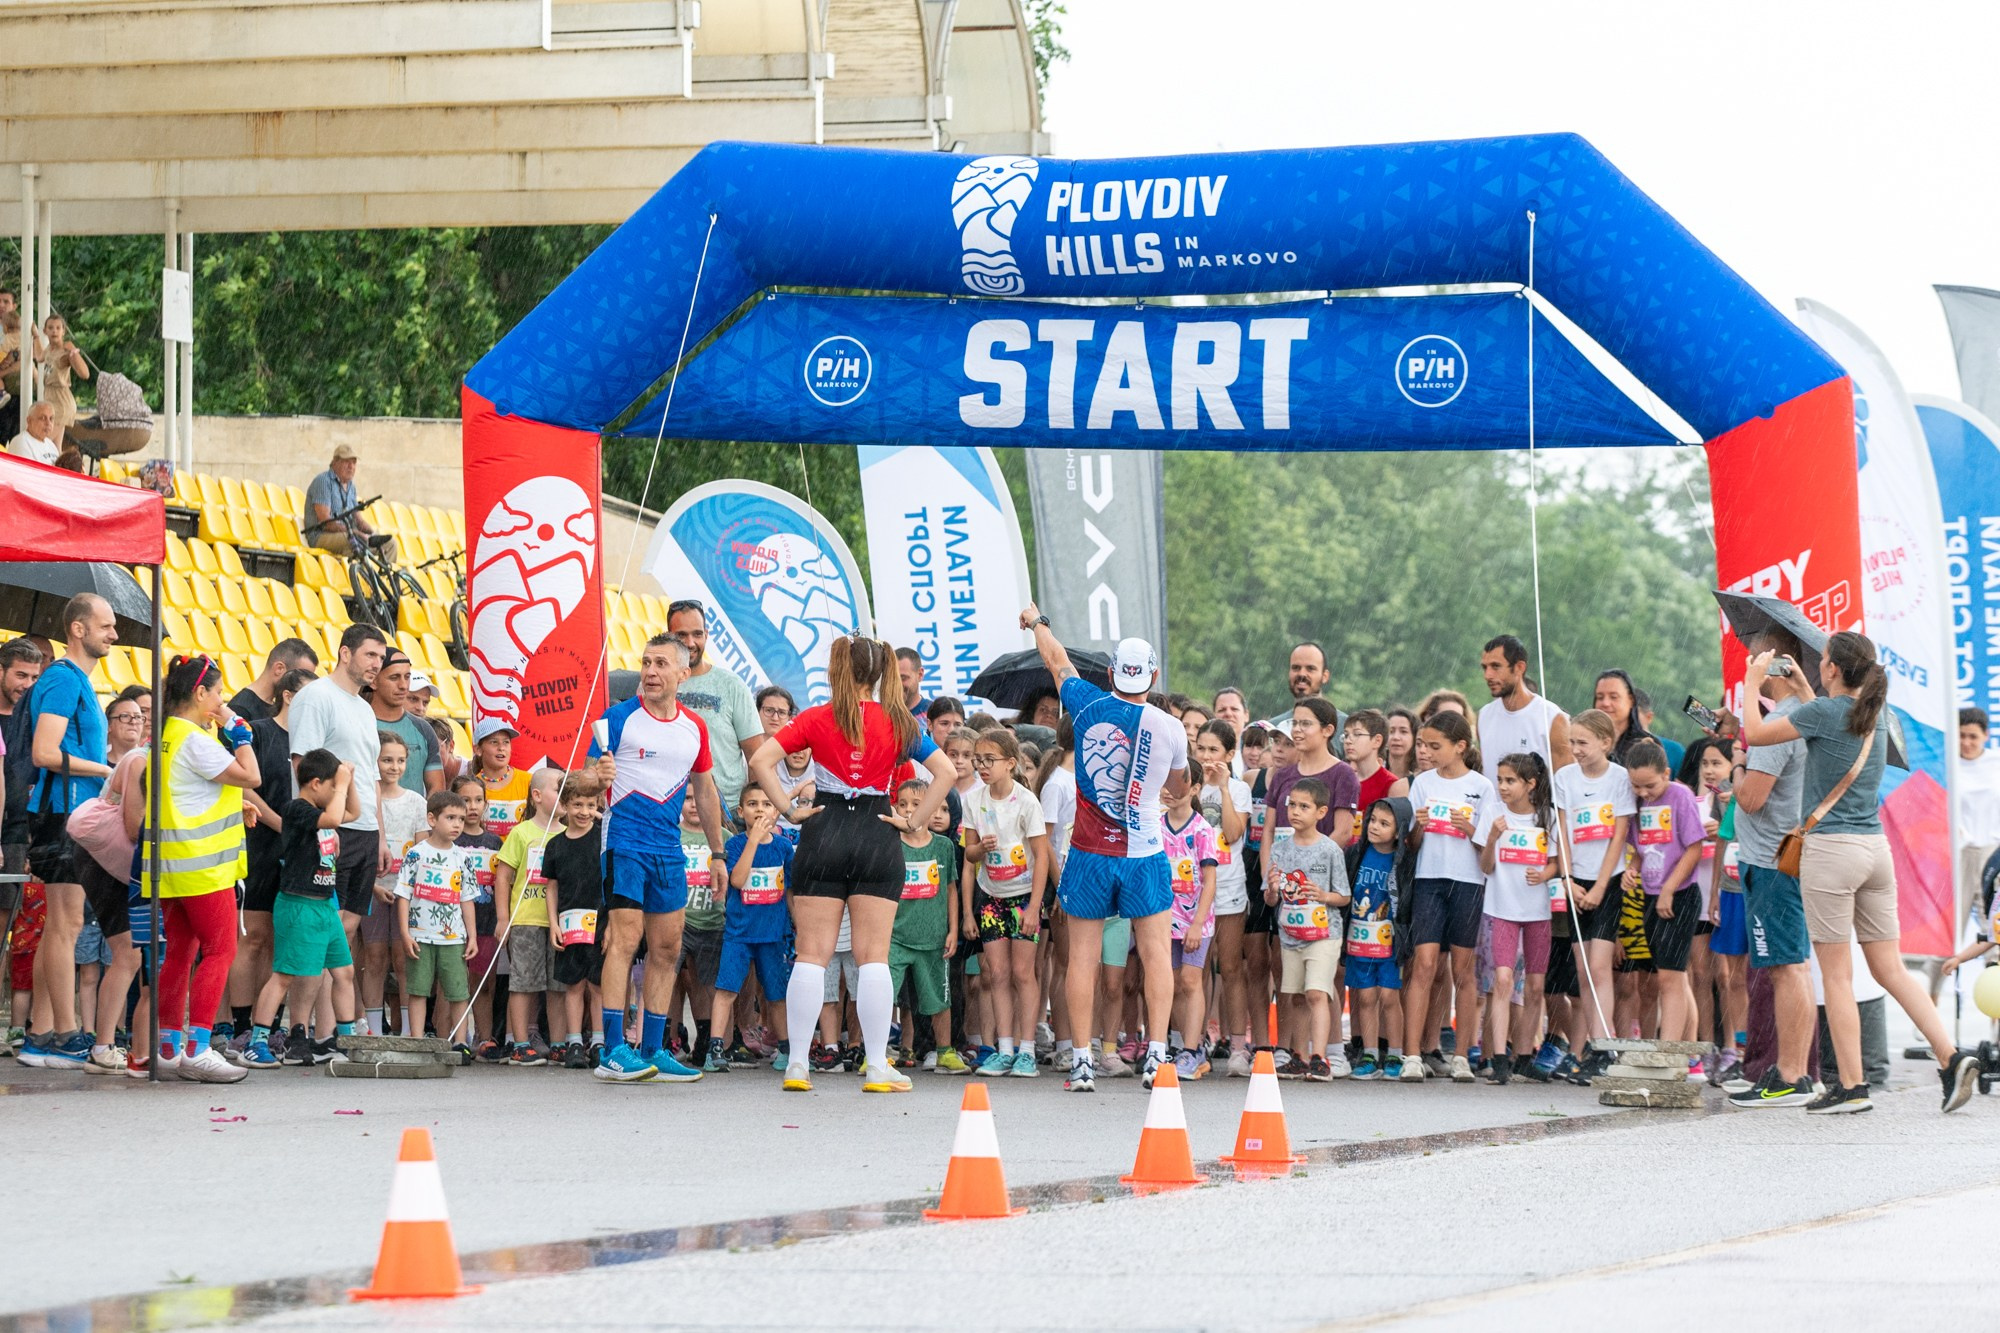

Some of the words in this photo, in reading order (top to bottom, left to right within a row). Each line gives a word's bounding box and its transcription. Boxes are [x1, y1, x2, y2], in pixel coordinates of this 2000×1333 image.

[1046, 174, 1228, 223] PLOVDIV
[1175, 236, 1199, 250] IN
[1045, 232, 1165, 276] HILLS
[1178, 251, 1298, 268] MARKOVO
[816, 357, 860, 380] P/H
[958, 317, 1310, 430] START
[1408, 357, 1455, 381] P/H
[521, 675, 578, 701] PLOVDIV
[535, 695, 574, 716] HILLS
[520, 724, 547, 743] TRAIL
[553, 733, 573, 742] RUN
[1134, 728, 1152, 782] MATTERS
[489, 807, 508, 820] 26
[1432, 804, 1449, 817] 47
[1576, 811, 1591, 825] 48
[1509, 833, 1528, 847] 46
[423, 870, 443, 885] 36
[751, 875, 769, 887] 81
[524, 887, 539, 899] SIX
[565, 917, 570, 929] 1
[1287, 912, 1305, 925] 60
[1352, 926, 1369, 940] 39
[1753, 928, 1770, 957] NIKE
